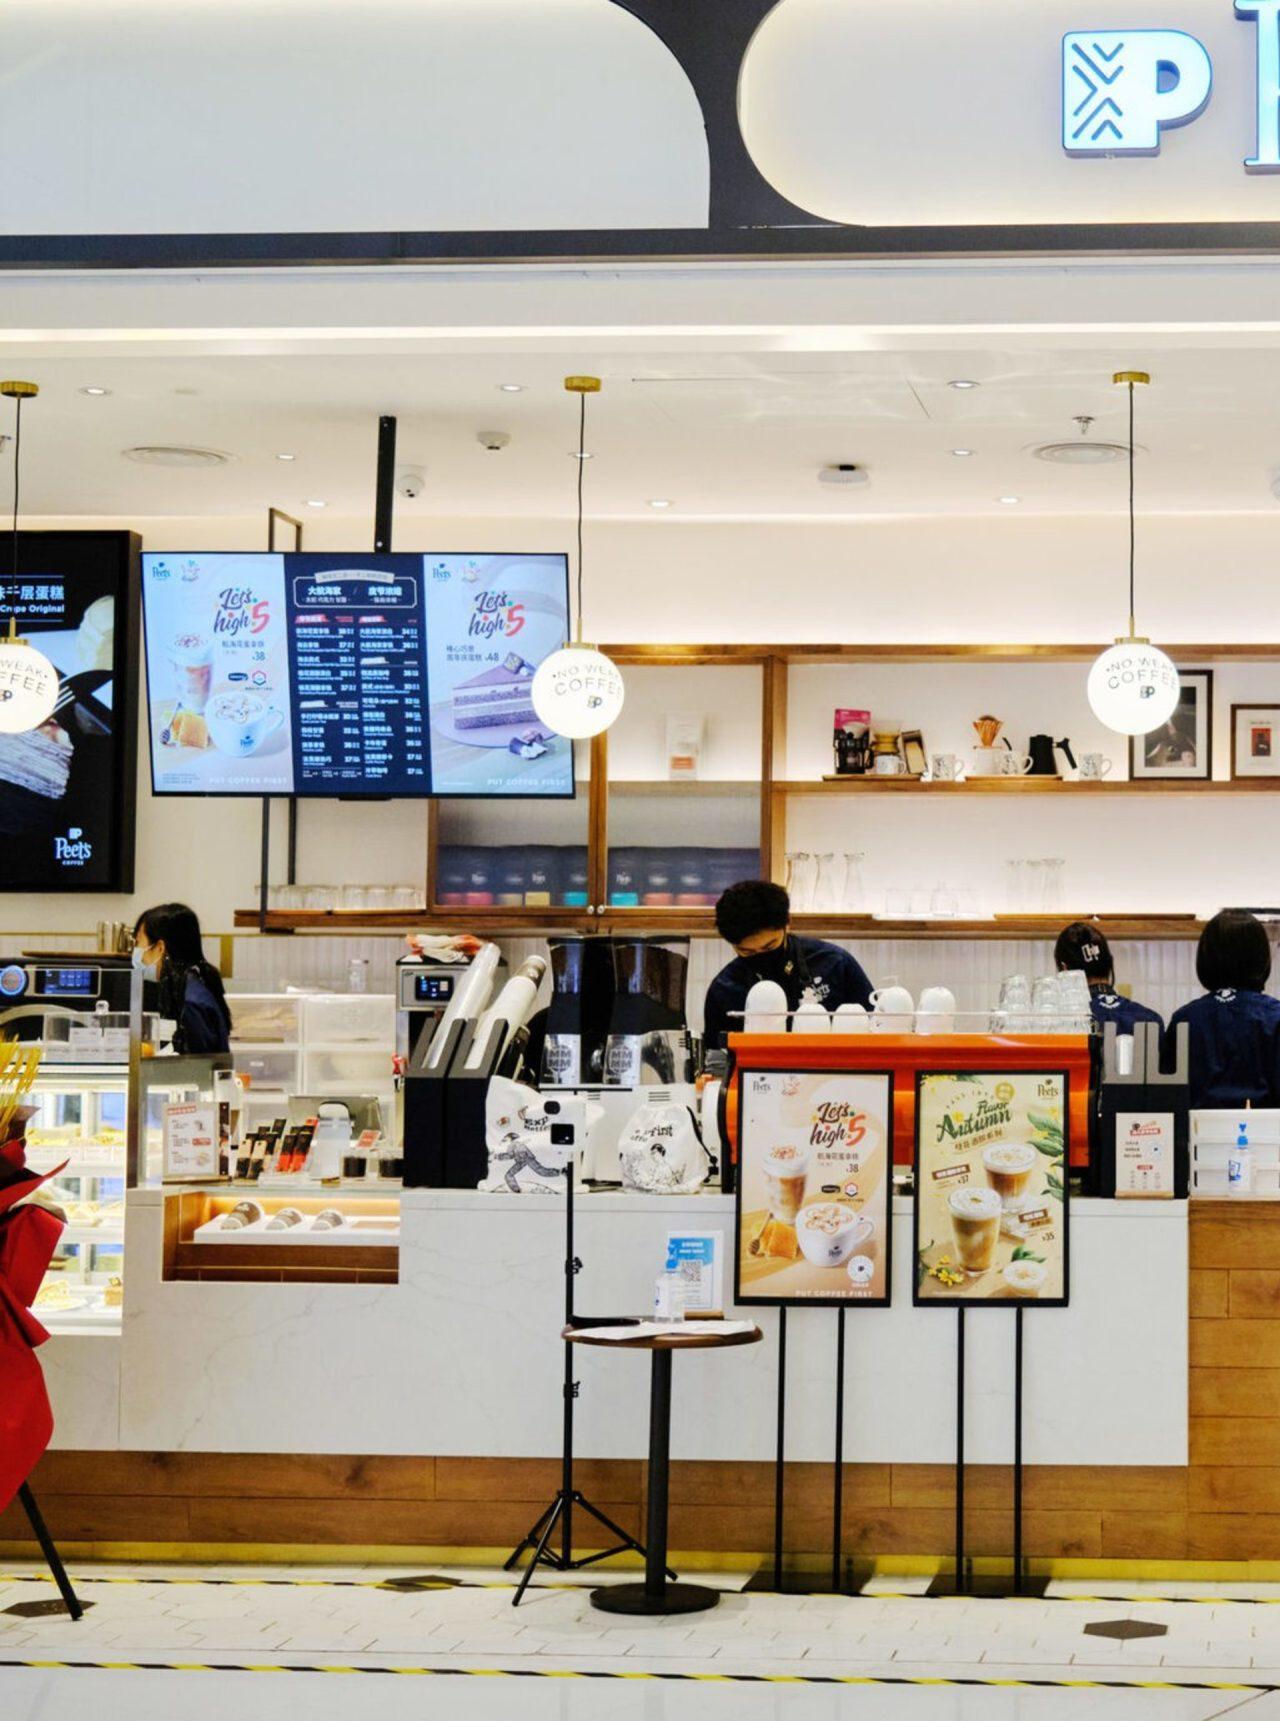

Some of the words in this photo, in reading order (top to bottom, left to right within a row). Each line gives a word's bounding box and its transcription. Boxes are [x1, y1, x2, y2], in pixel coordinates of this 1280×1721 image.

[29, 603, 65, 614] Original
[219, 588, 253, 611] Let's
[474, 591, 508, 614] Let's
[213, 609, 250, 637] high
[250, 600, 271, 634] 5
[468, 612, 504, 639] high
[505, 604, 526, 637] 5
[817, 1101, 851, 1124] Let's
[976, 1100, 1009, 1117] Flavor
[810, 1123, 846, 1149] high
[845, 1113, 867, 1147] 5
[936, 1109, 1012, 1142] Autumn
